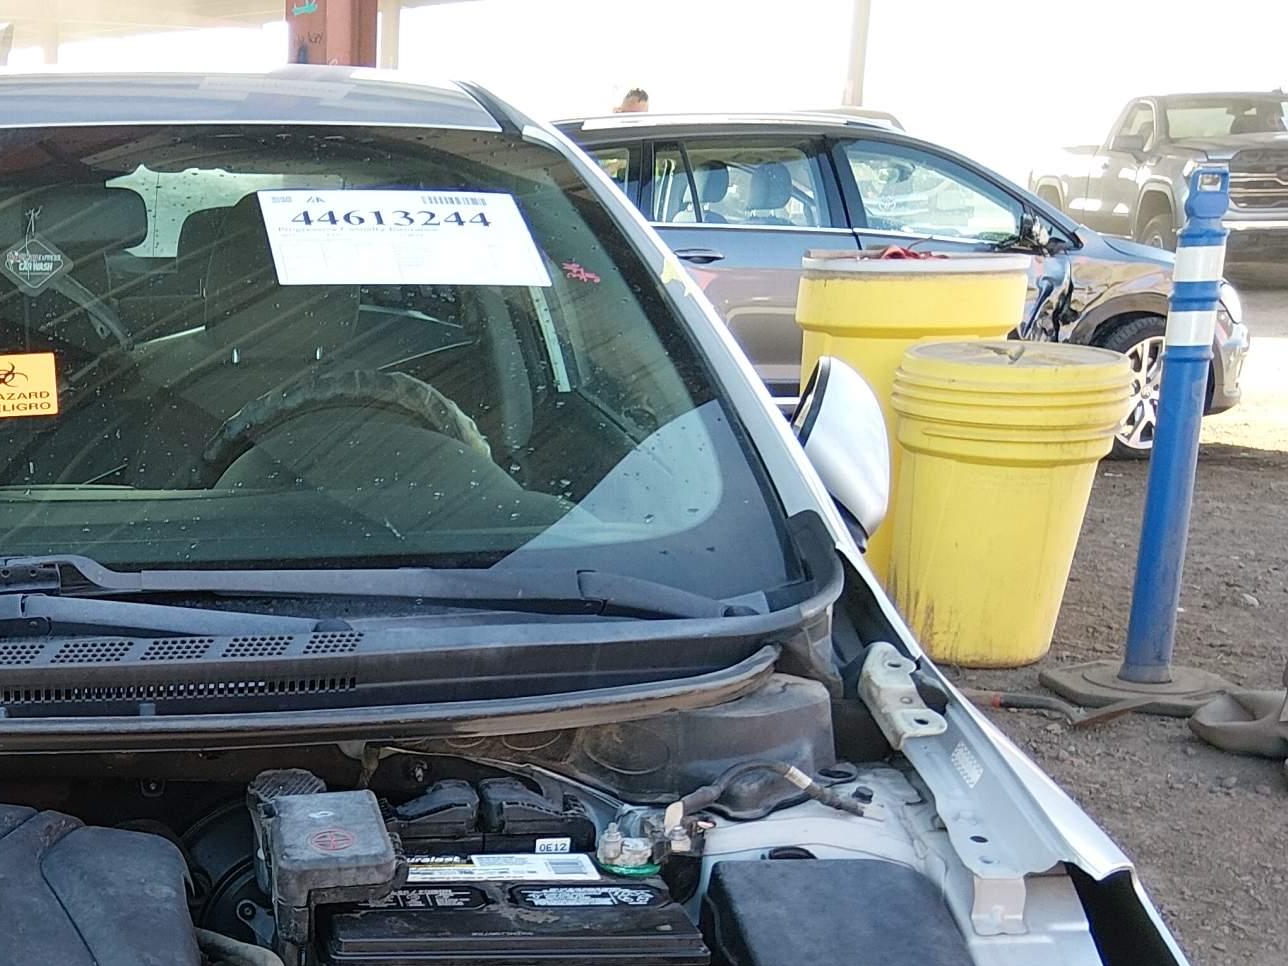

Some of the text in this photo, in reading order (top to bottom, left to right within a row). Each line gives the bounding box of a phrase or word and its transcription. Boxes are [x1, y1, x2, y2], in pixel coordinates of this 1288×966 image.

[291, 209, 491, 227] 44613244
[32, 262, 53, 271] WASH
[406, 855, 461, 863] uralast
